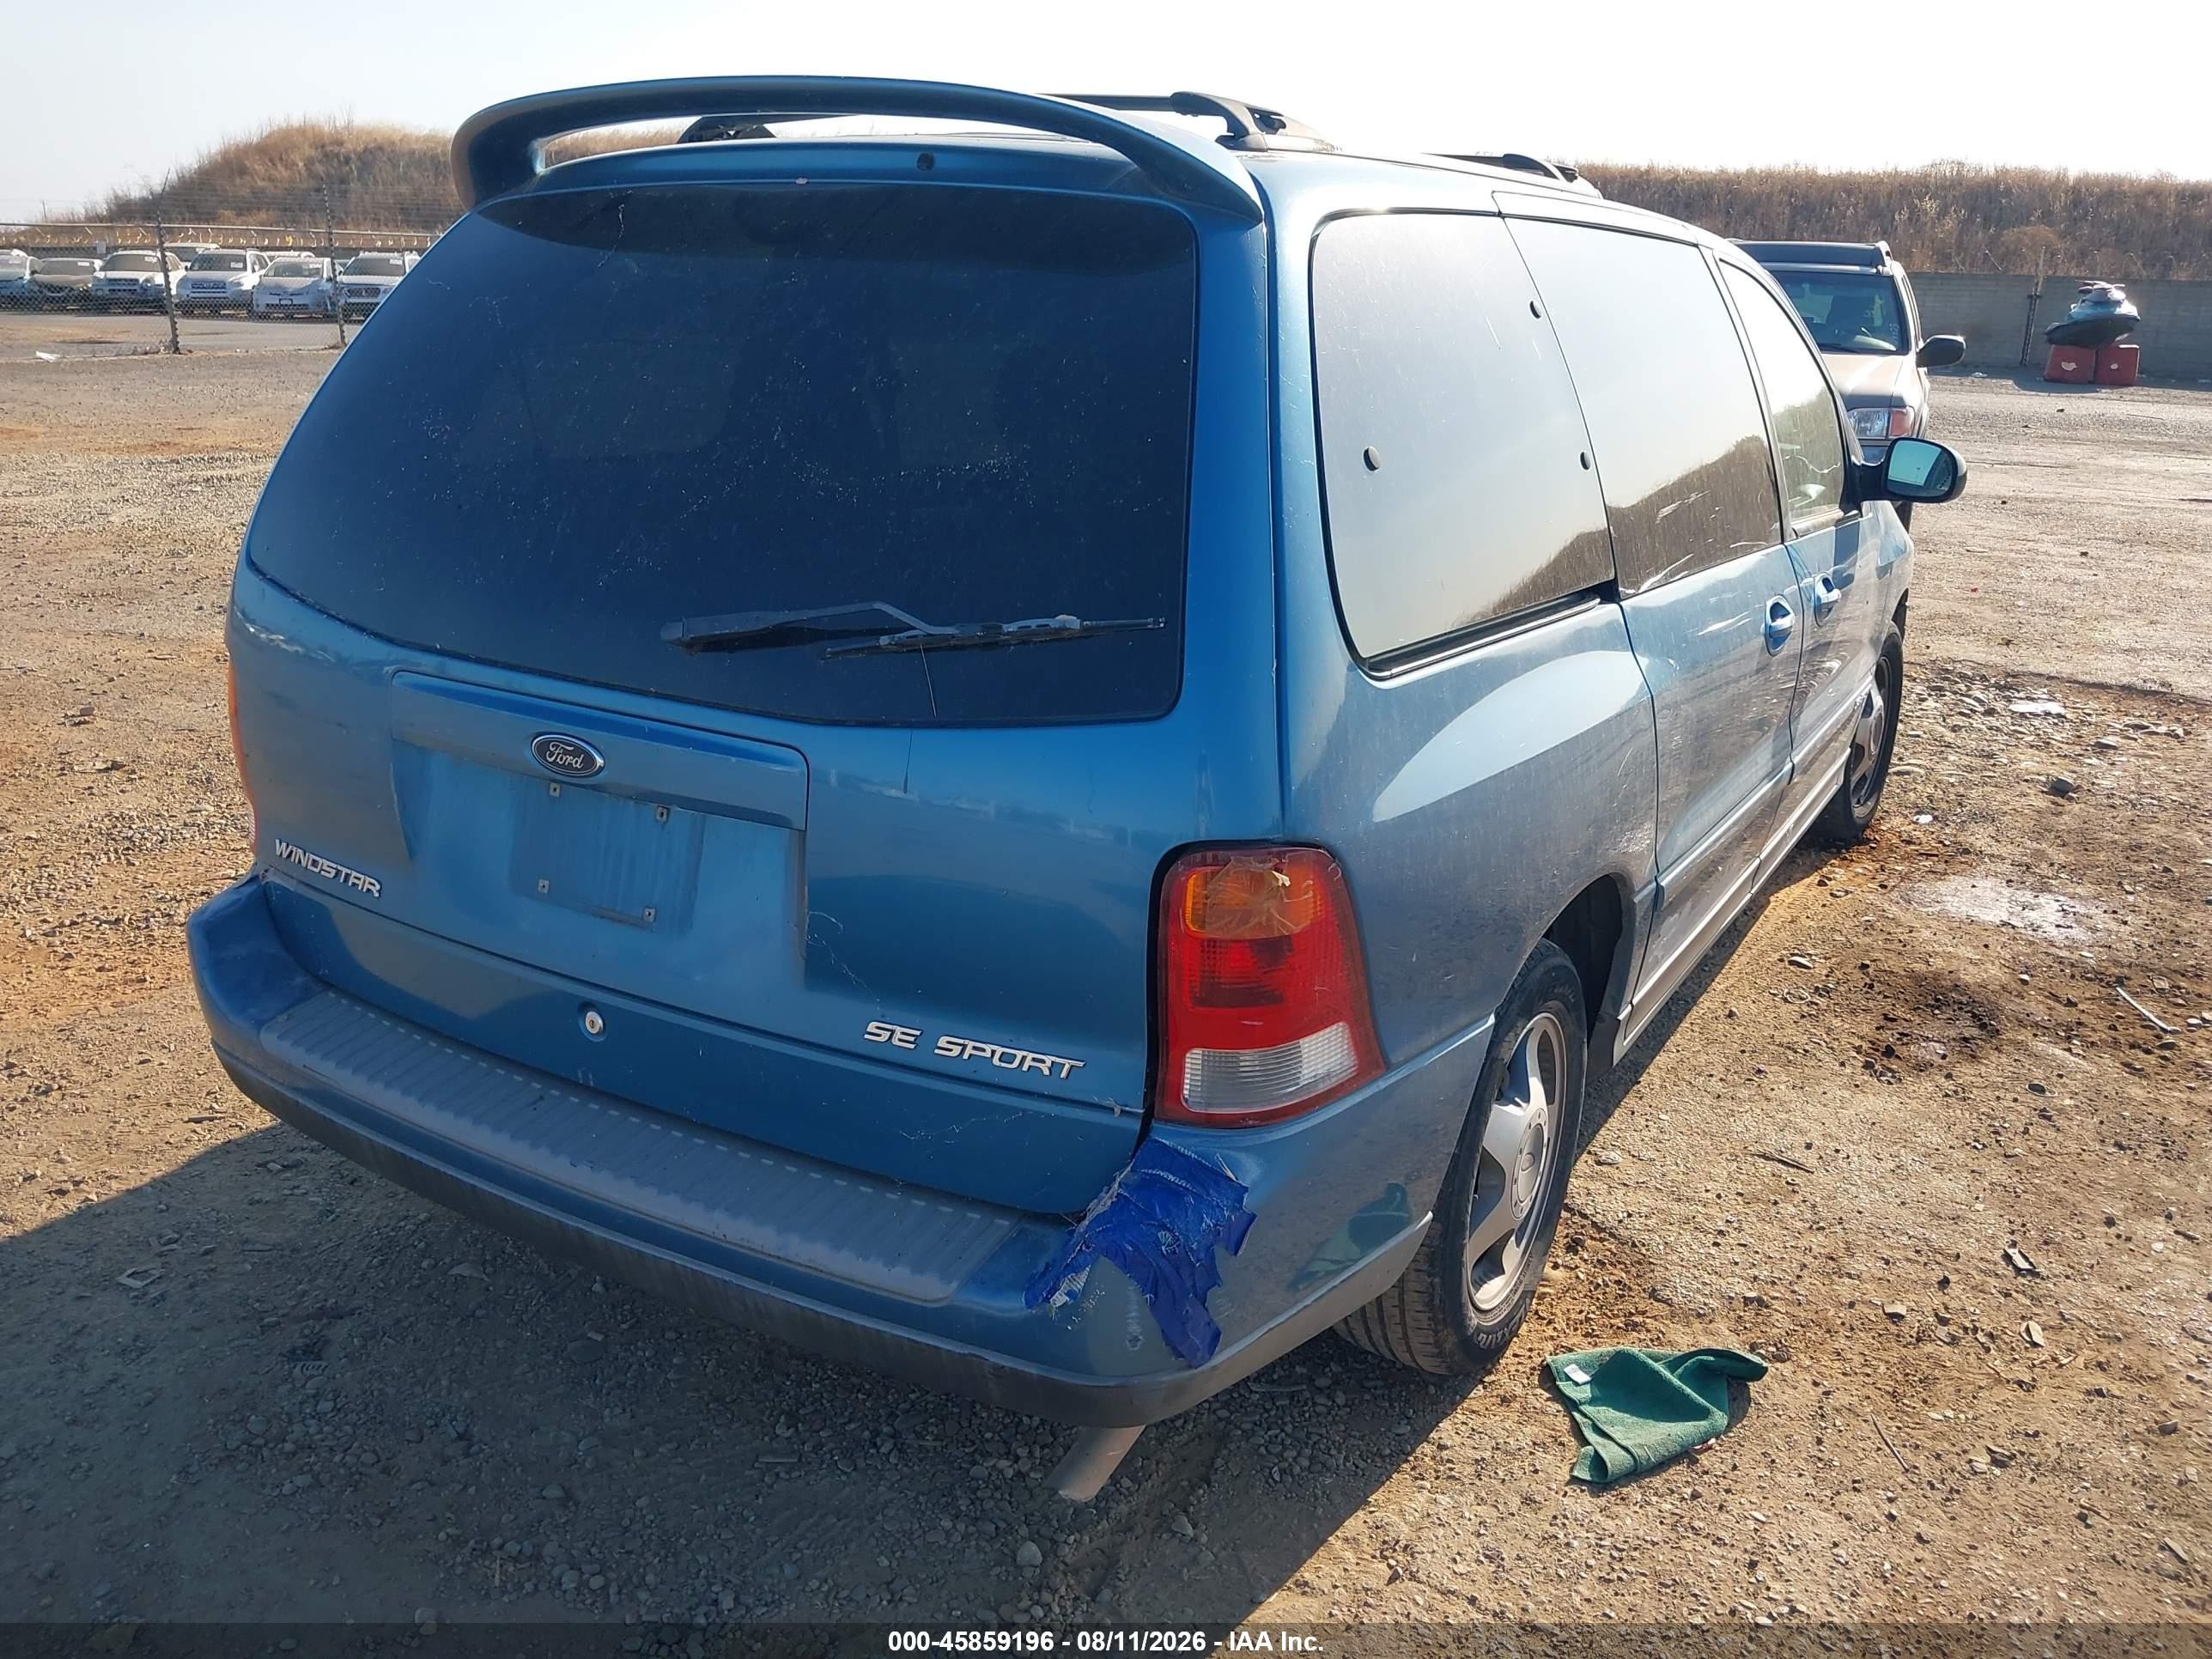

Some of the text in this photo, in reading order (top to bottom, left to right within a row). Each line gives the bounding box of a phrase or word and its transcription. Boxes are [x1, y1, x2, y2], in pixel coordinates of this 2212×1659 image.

[546, 741, 585, 769] Ford
[275, 838, 381, 898] WINDSTAR
[864, 1021, 1086, 1079] SE SPORT
